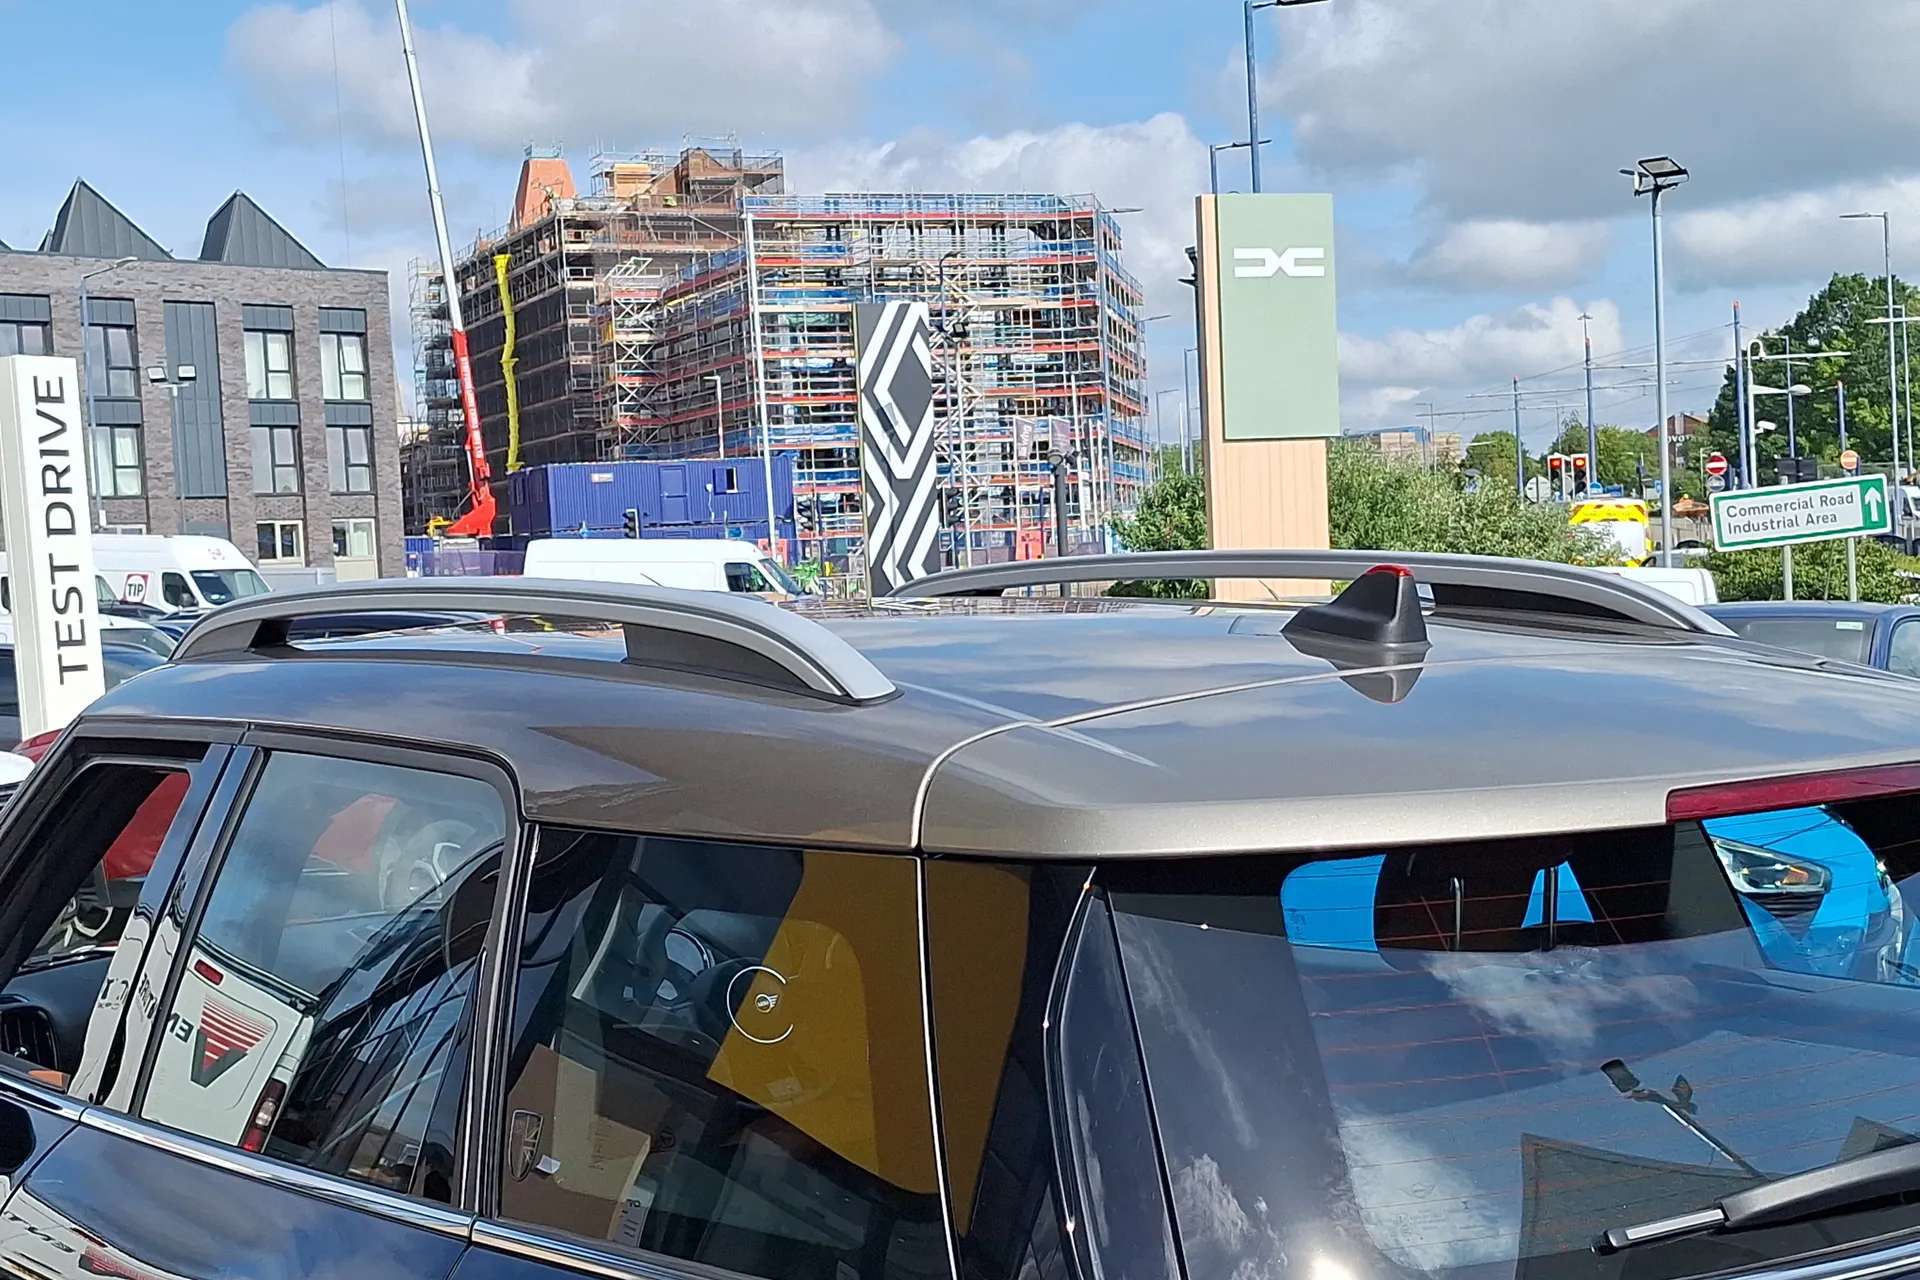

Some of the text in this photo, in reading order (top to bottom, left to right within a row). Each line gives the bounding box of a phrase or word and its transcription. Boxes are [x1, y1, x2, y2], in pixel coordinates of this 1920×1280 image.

[1726, 492, 1854, 518] Commercial Road
[33, 376, 88, 685] TEST DRIVE
[1728, 512, 1837, 534] Industrial Area
[127, 583, 144, 597] TIP
